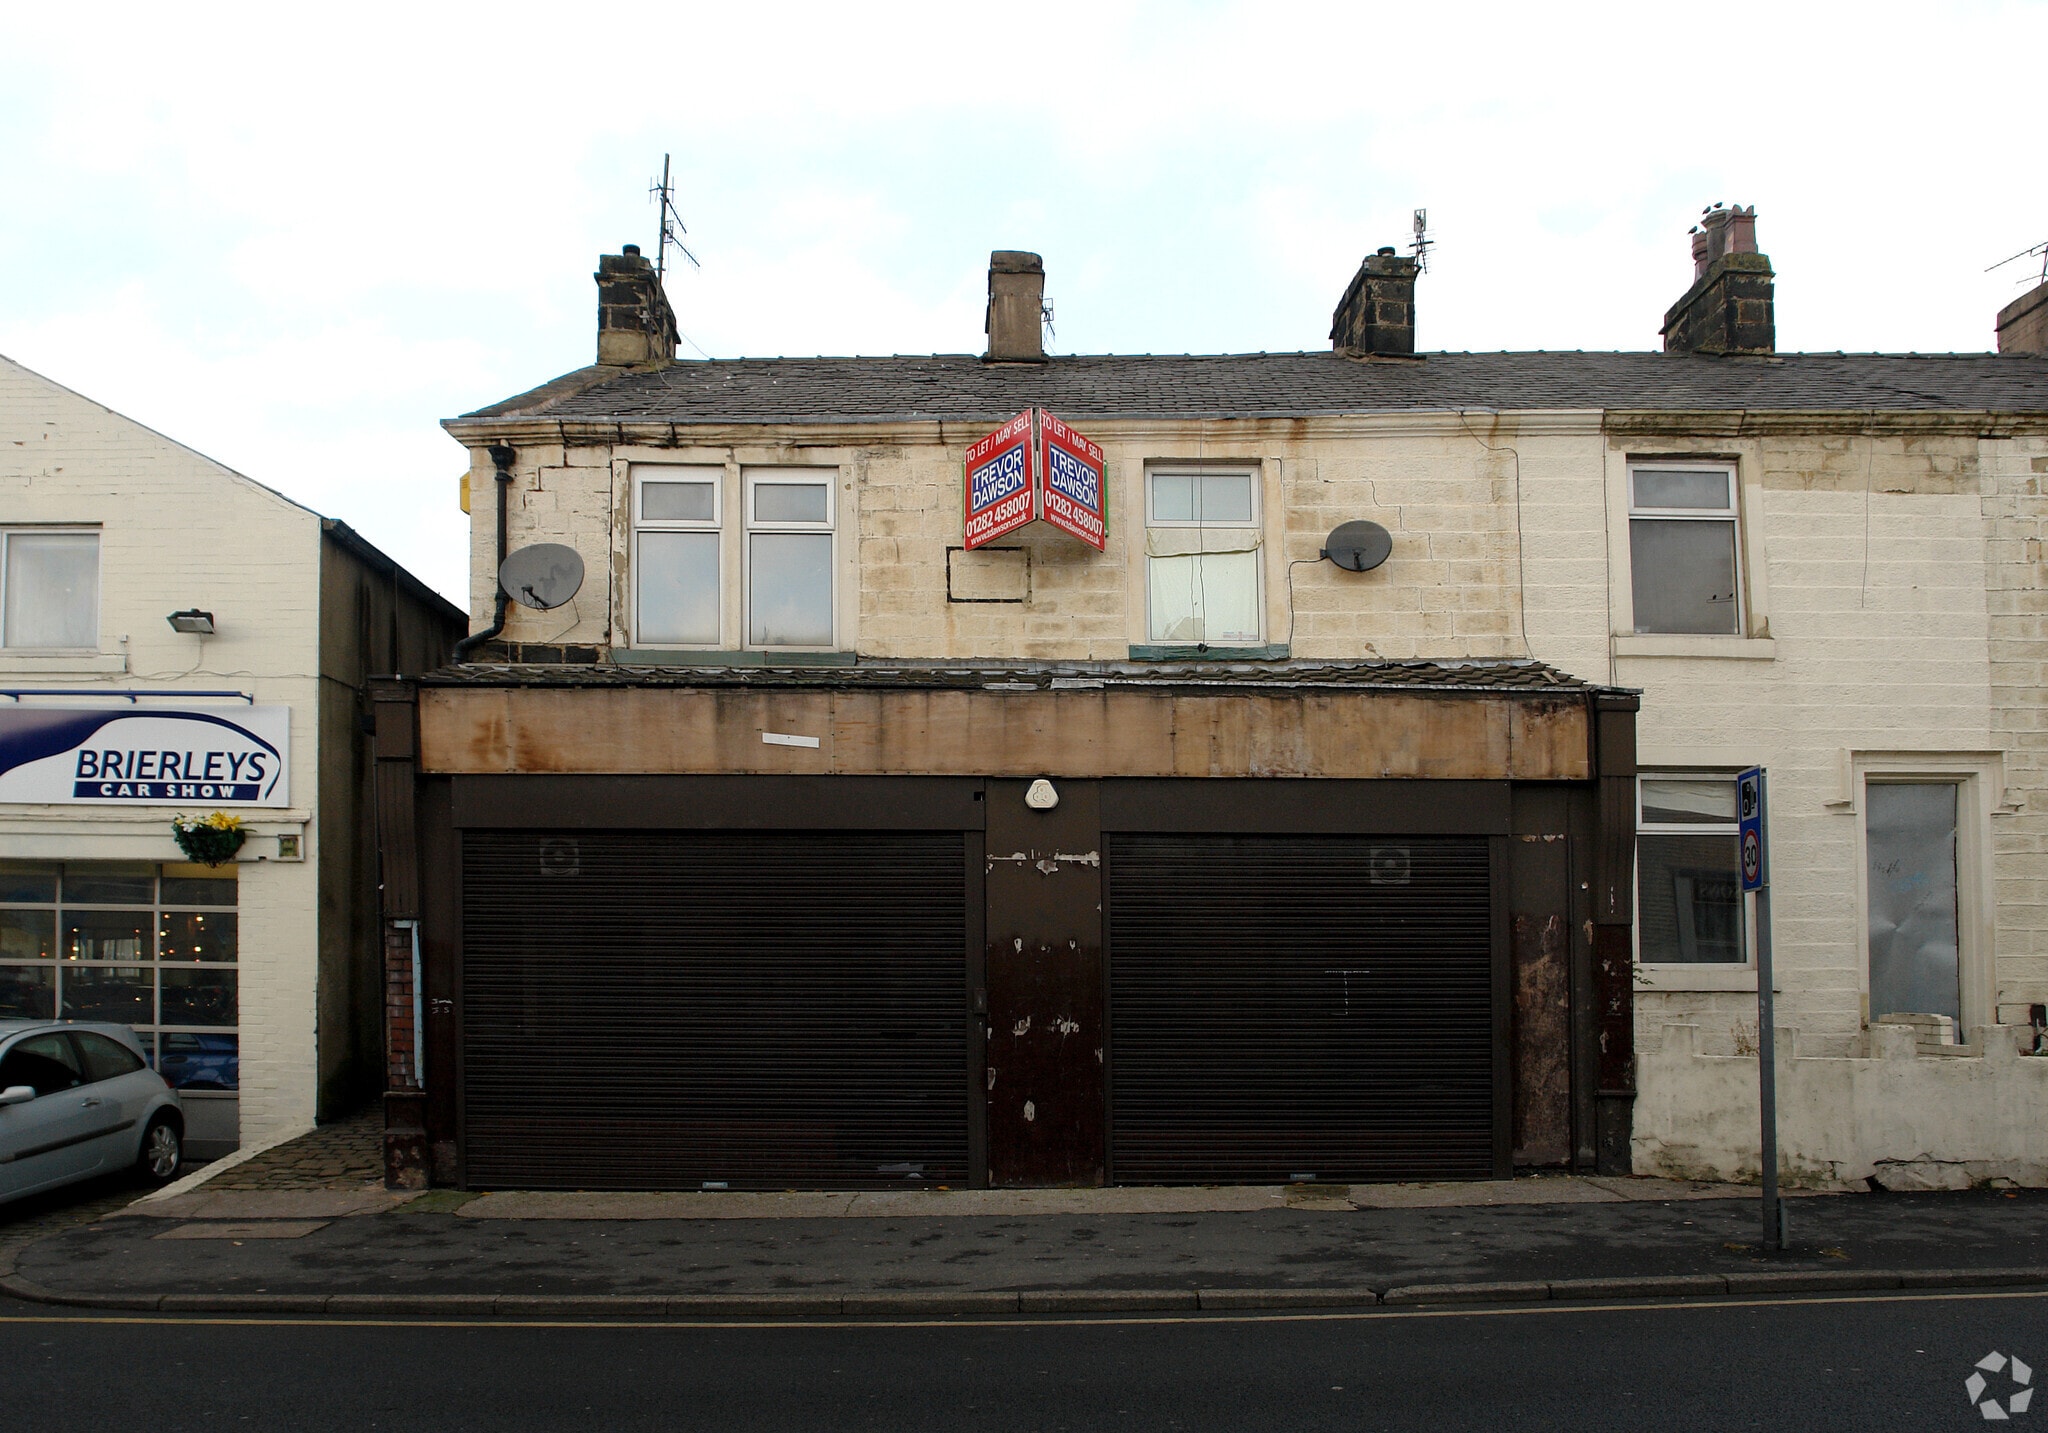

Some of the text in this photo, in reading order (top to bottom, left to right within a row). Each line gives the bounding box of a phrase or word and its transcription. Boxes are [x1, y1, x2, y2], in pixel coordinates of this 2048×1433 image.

[966, 448, 976, 463] TO
[977, 439, 990, 457] LET
[995, 425, 1012, 446] MAY
[1013, 414, 1030, 435] SELL
[1041, 413, 1052, 430] TO
[1053, 421, 1066, 439] LET
[1071, 432, 1087, 452] MAY
[1088, 443, 1103, 463] SELL
[973, 448, 1023, 491] TREVOR
[973, 466, 1023, 510] DAWSON
[1050, 447, 1097, 491] TREVOR
[1051, 466, 1098, 509] DAWSON
[966, 490, 1031, 537] 01282 458007
[1045, 490, 1103, 536] 01282 458007
[75, 749, 266, 781] BRIERLEYS
[100, 783, 236, 798] CAR SHOW
[1745, 844, 1757, 868] 30
